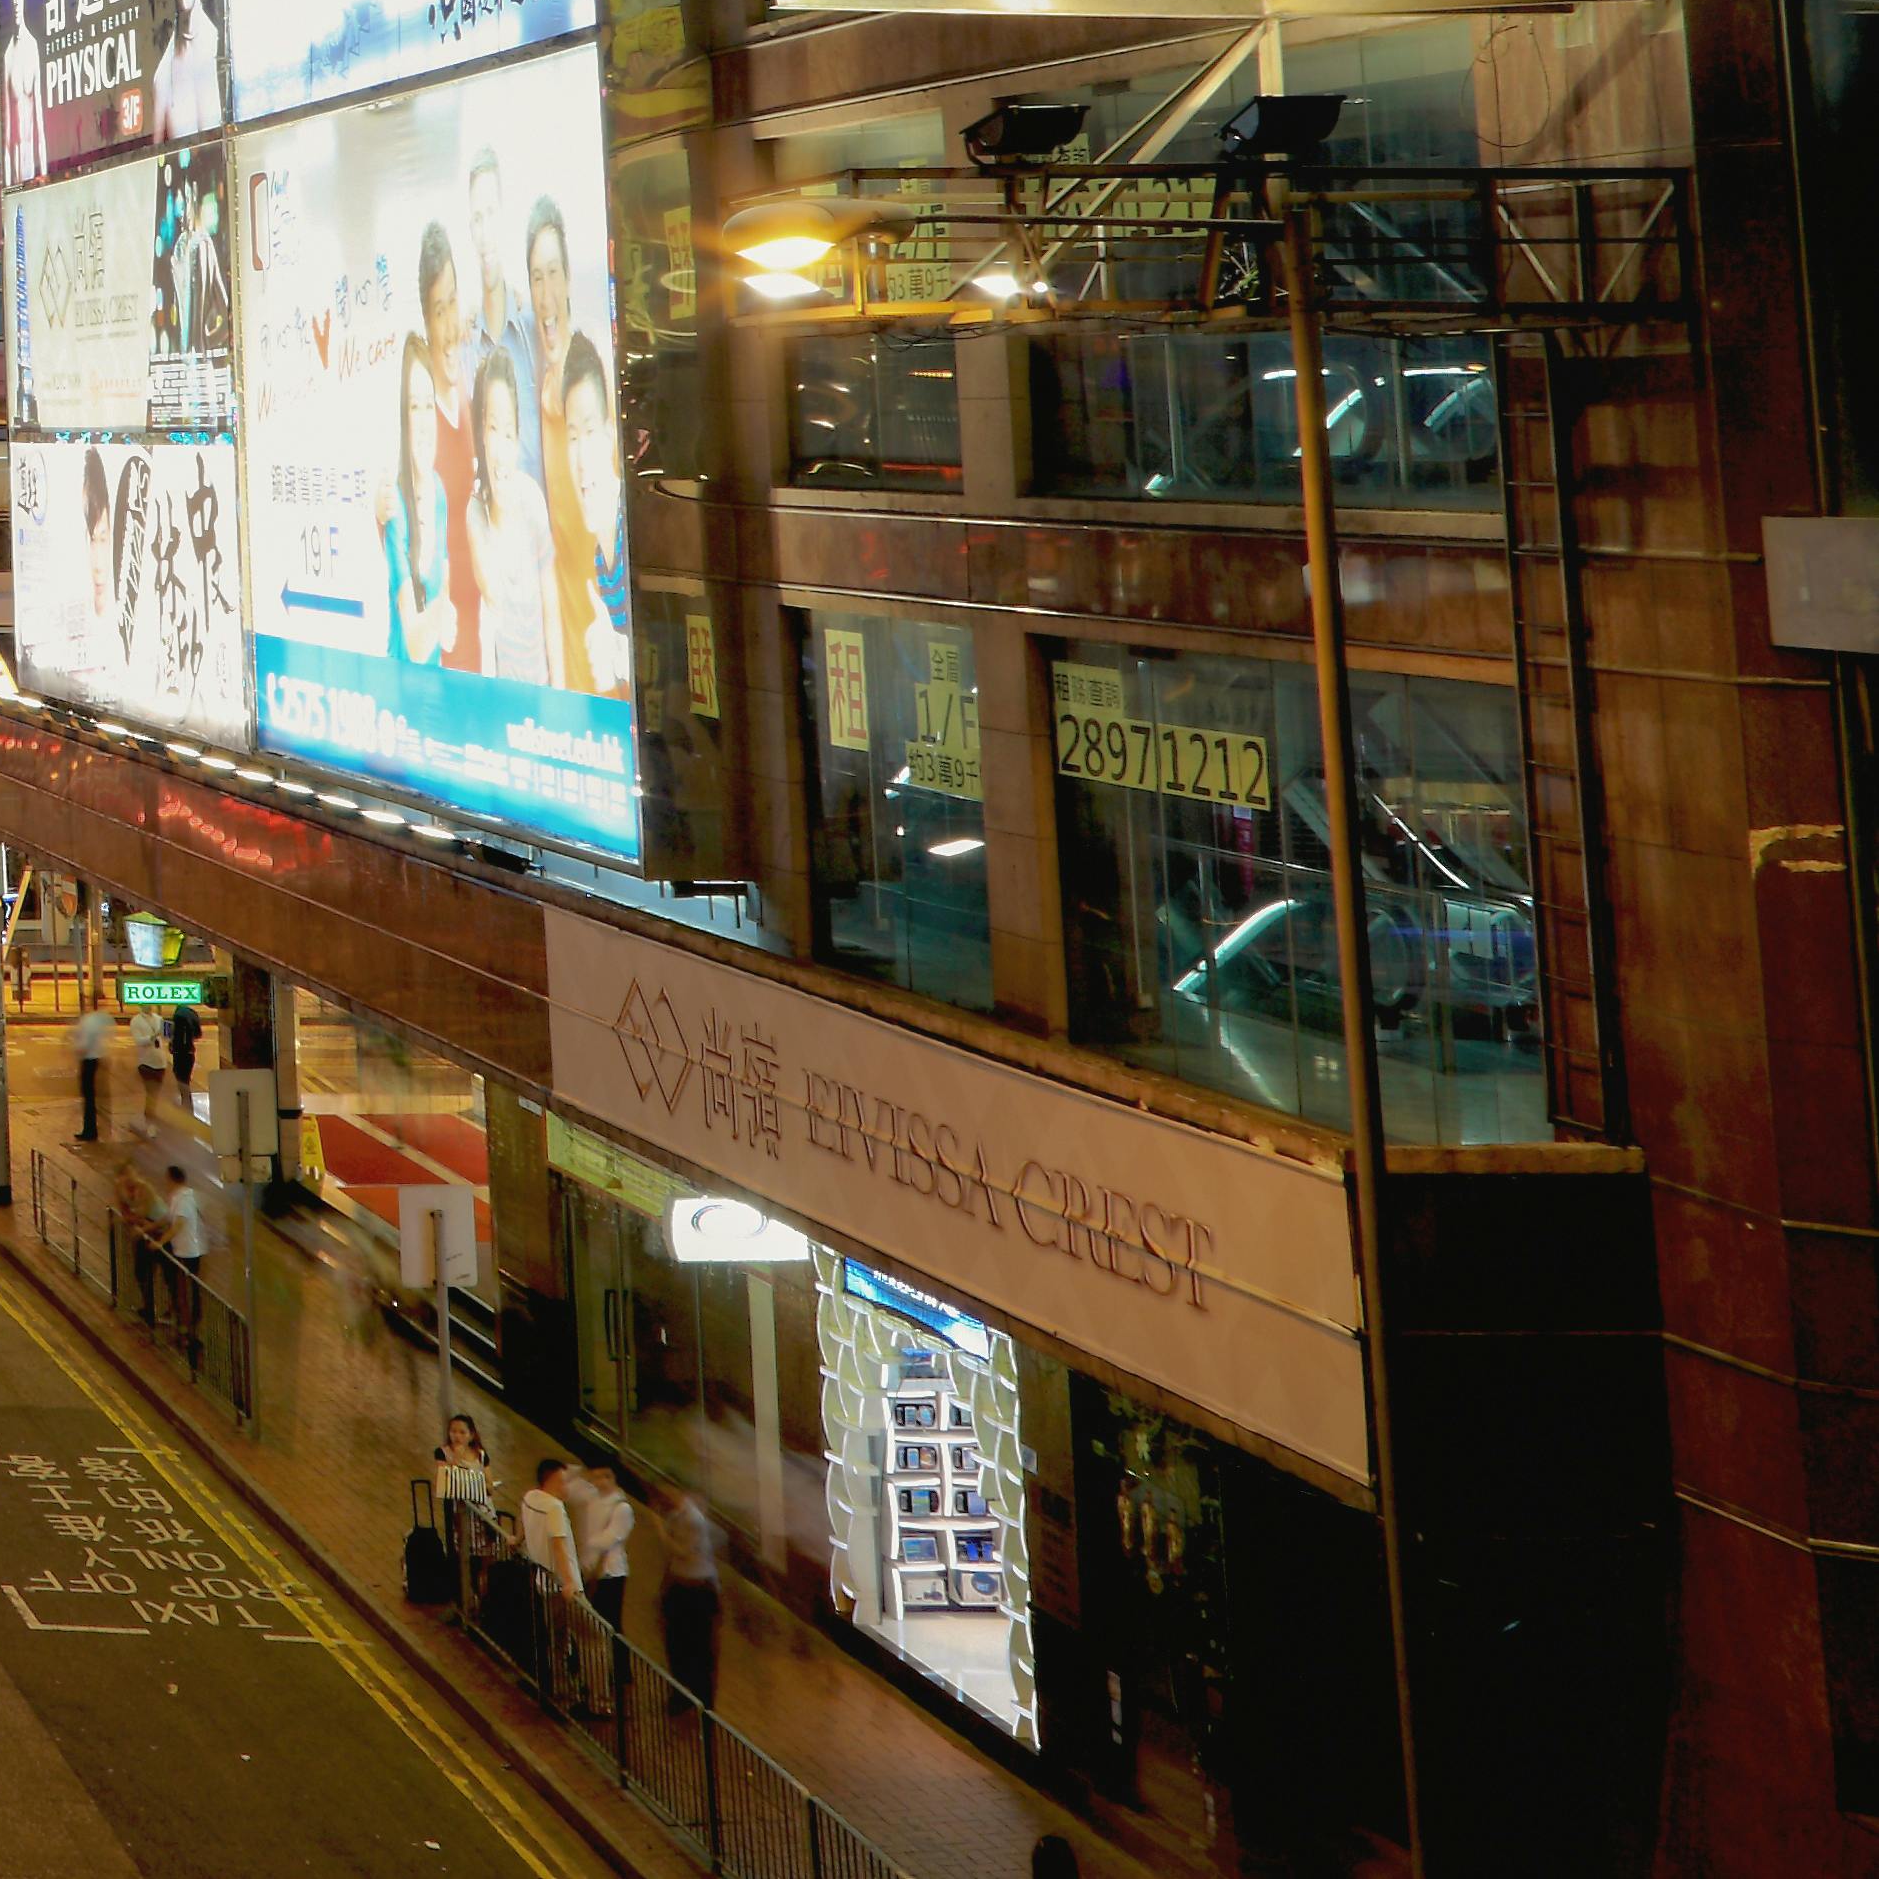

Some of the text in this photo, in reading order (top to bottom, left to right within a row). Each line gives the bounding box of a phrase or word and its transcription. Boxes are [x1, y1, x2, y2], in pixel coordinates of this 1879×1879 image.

[46, 29, 142, 109] PHYSICAL
[123, 95, 141, 130] 3/F
[907, 747, 983, 794] 約3萬9千
[127, 985, 199, 1001] ROLEX
[802, 1067, 1218, 1314] EIVISSA CREST
[84, 1547, 226, 1572] ONLY
[24, 1570, 138, 1595] OFF
[131, 1599, 272, 1629] TAXI
